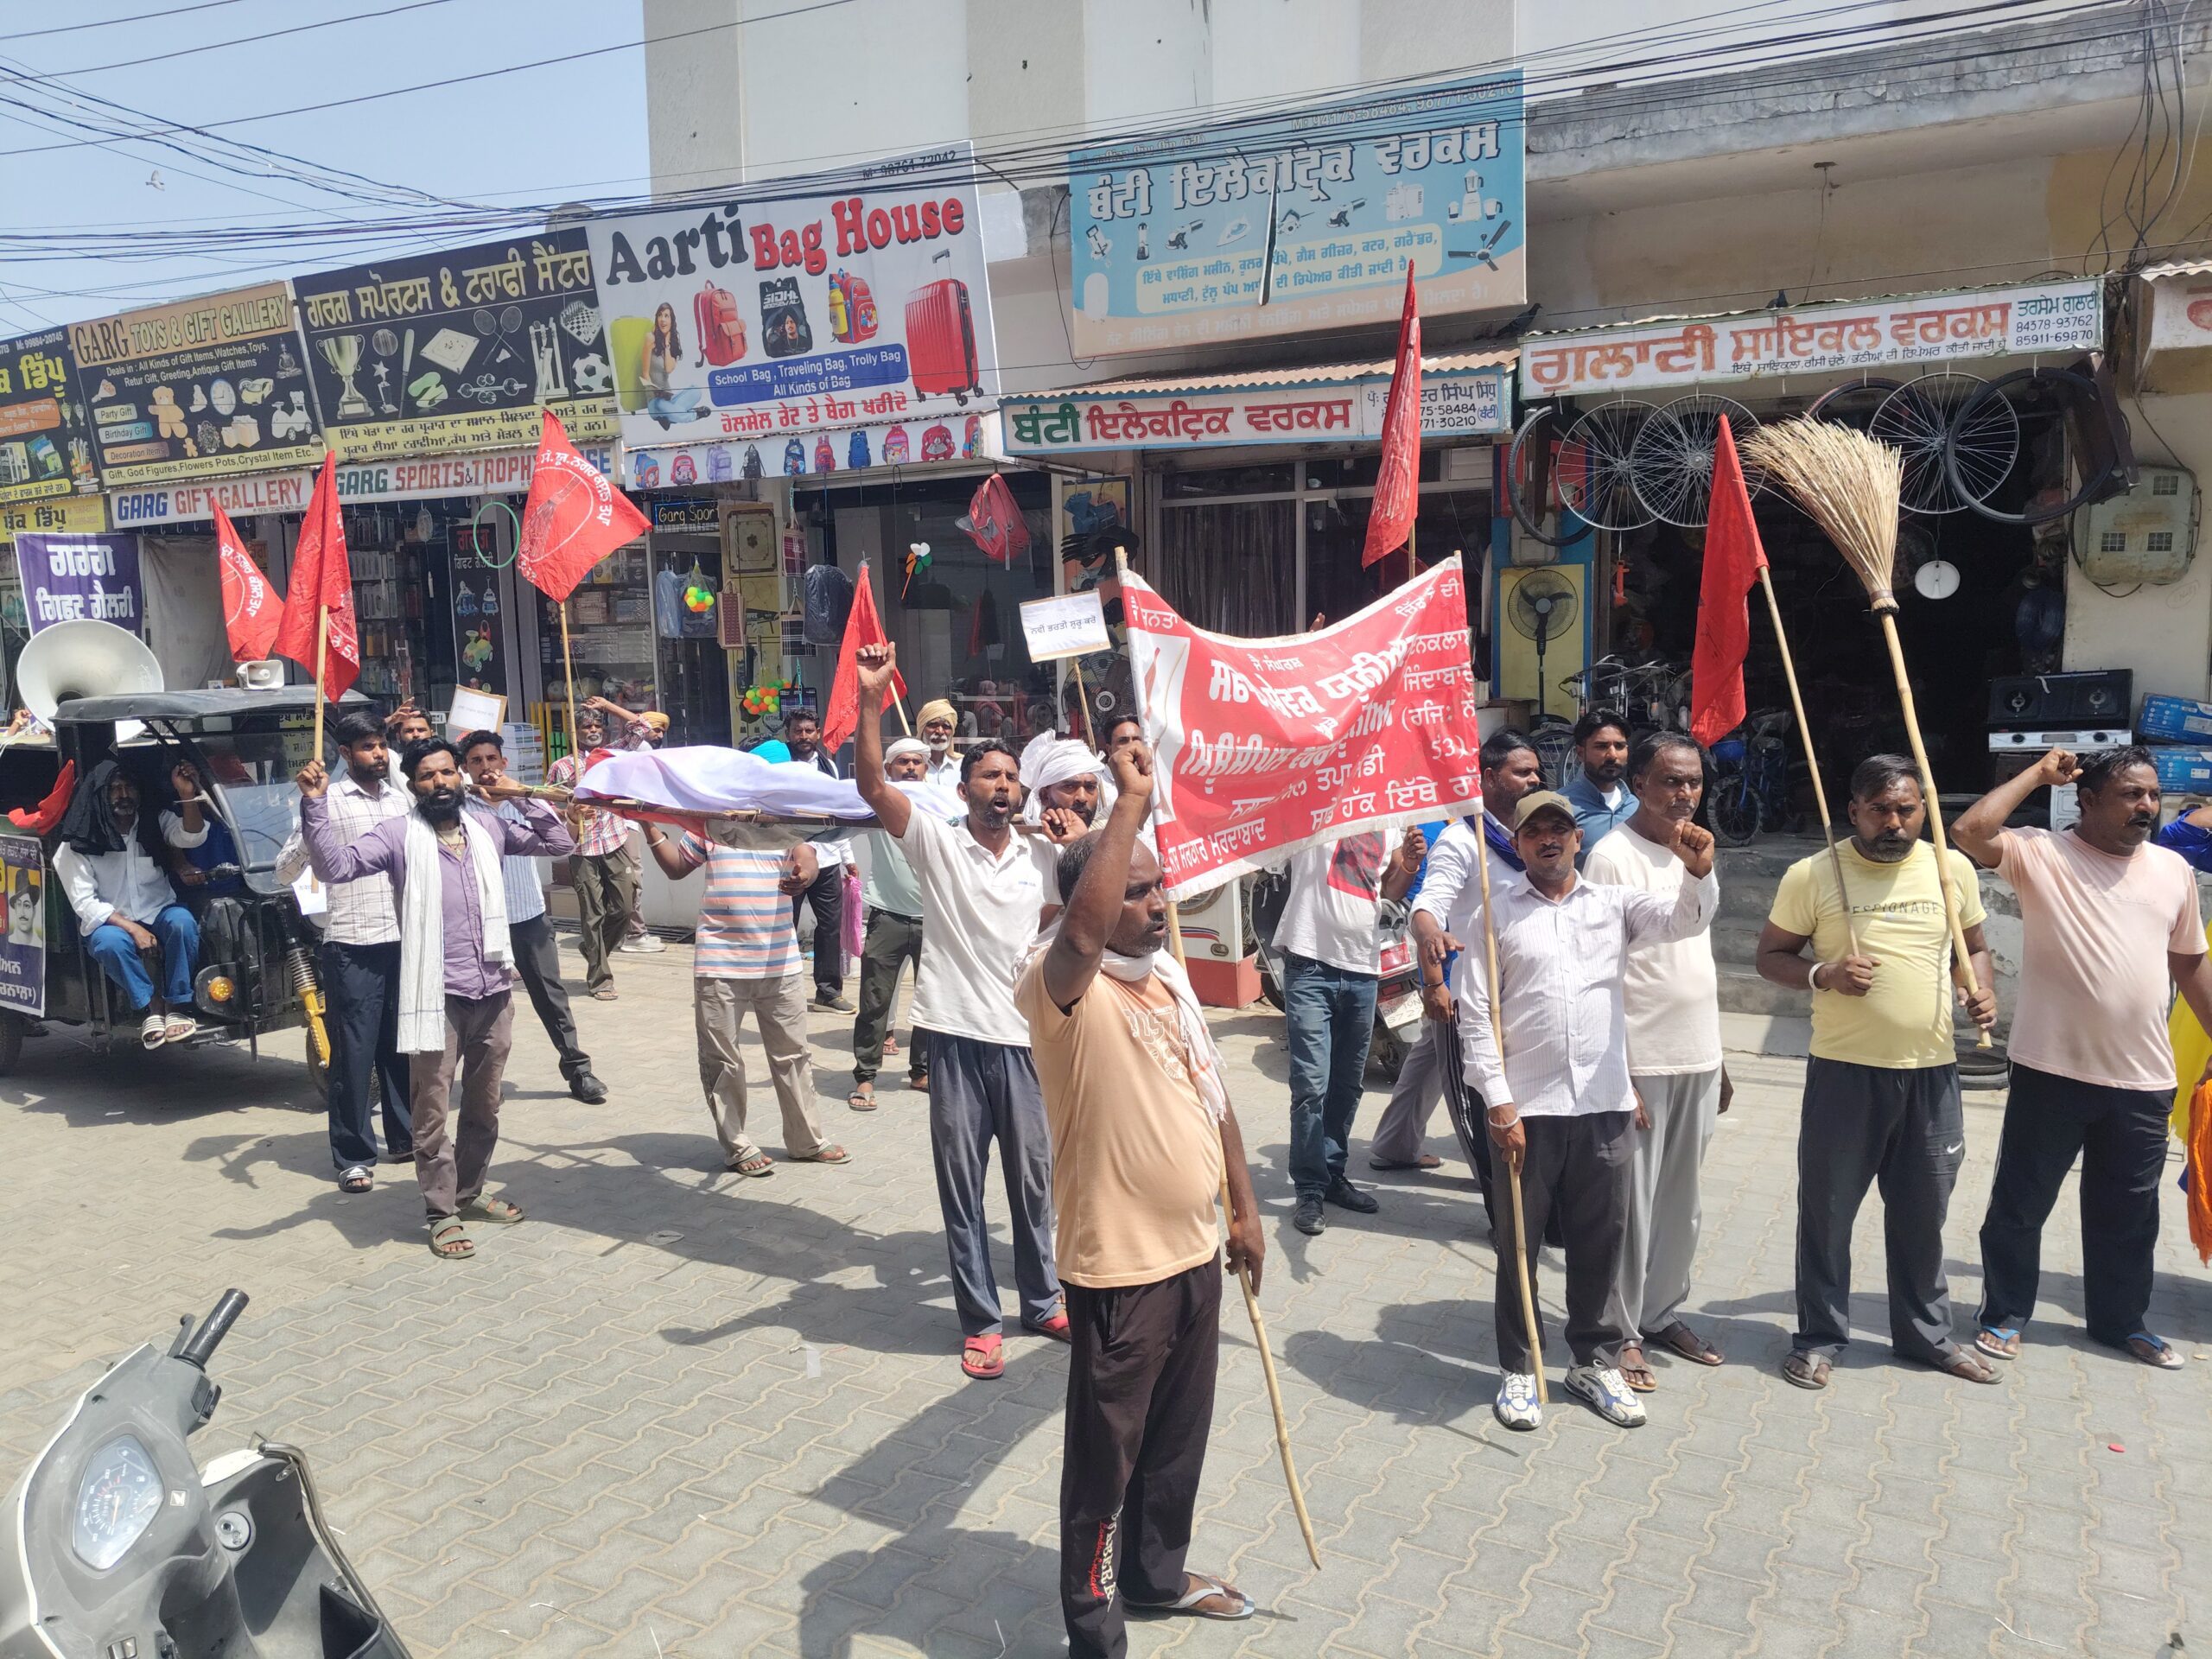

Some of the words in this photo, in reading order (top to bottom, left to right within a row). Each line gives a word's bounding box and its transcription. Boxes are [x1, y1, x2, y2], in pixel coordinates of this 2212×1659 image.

[1088, 168, 1154, 221] ਬੰਟੀ
[1375, 118, 1501, 175] ਵਰਕਸ
[607, 203, 748, 286] Aarti
[749, 219, 828, 276] Bag
[831, 197, 965, 257] House
[304, 290, 353, 327] ਗਰਗ
[440, 267, 461, 308] &
[462, 247, 527, 303] ਟਰਾਫੀ
[532, 240, 591, 292] ਸੈਂਟਰ
[75, 318, 130, 364] GARG
[130, 319, 168, 353] TOYS
[170, 315, 182, 346] &
[183, 308, 217, 344] GIFT
[219, 295, 288, 338] GALLERY
[2016, 315, 2093, 333] 84378-93762
[2016, 329, 2094, 346] 85911-69870
[1530, 324, 1719, 392] ਗੁਲਾਟੀ
[1890, 302, 2012, 346] ਵਰਕਸ
[106, 364, 125, 377] Deals
[126, 361, 134, 373] in
[139, 359, 149, 372] All
[149, 356, 170, 370] Kinds
[171, 353, 179, 366] of
[180, 352, 194, 365] Gift
[221, 360, 235, 373] Gift
[236, 358, 257, 372] Items
[715, 373, 747, 385] School
[752, 369, 771, 382] Bag
[778, 361, 822, 378] Traveling
[825, 357, 848, 372] Bag,
[849, 353, 877, 367] Trolly
[880, 350, 900, 363] Bag
[773, 385, 785, 397] All
[788, 381, 817, 395] Kinds
[819, 379, 829, 390] of
[831, 375, 851, 389] Bag
[100, 408, 118, 420] Party
[120, 407, 132, 416] Gift
[778, 402, 800, 427] ਰੇਟ
[806, 397, 819, 424] ਤੇ
[825, 393, 855, 420] ਬੈਗ
[1012, 403, 1080, 445] ਬੰਟੀ
[1244, 398, 1353, 431] ਵਰਕਸ
[1420, 403, 1477, 416] 75-58484
[105, 428, 133, 440] Birthday
[134, 425, 147, 436] Gift
[108, 469, 126, 480] Gift,
[127, 467, 144, 479] God
[273, 451, 293, 463] Item
[296, 447, 315, 459] Etc.
[111, 448, 145, 461] Decoration
[335, 468, 388, 495] GARG
[396, 461, 464, 492] SPORTS
[118, 492, 168, 521] GARG
[218, 477, 302, 510] GALLERY
[658, 506, 685, 526] Garg
[46, 544, 116, 576] ਗਰਗ
[1342, 787, 1376, 817] ਹੱਕ
[1385, 776, 1438, 810] ਇੱਥੇ
